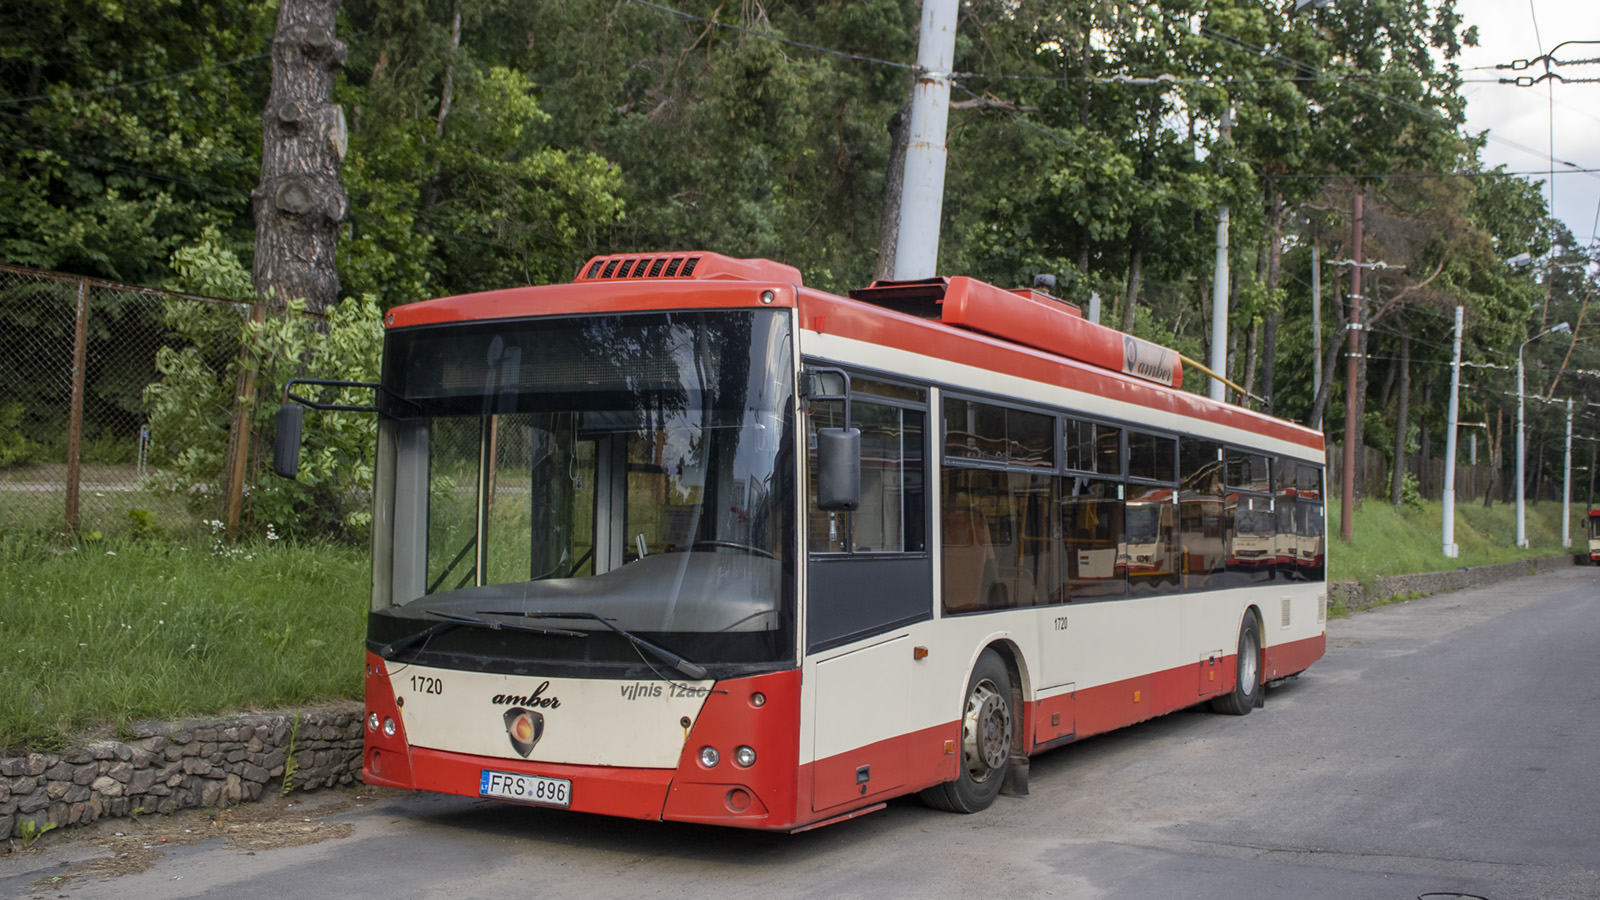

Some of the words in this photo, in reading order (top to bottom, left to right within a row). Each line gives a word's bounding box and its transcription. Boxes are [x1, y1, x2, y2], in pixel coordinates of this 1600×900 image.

[1137, 349, 1171, 381] amber
[1054, 616, 1068, 631] 1720
[411, 675, 443, 695] 1720
[492, 681, 561, 709] amber
[620, 682, 662, 700] vilnis
[668, 683, 707, 698] 12ac
[490, 775, 525, 795] FRS
[536, 781, 566, 801] 896
